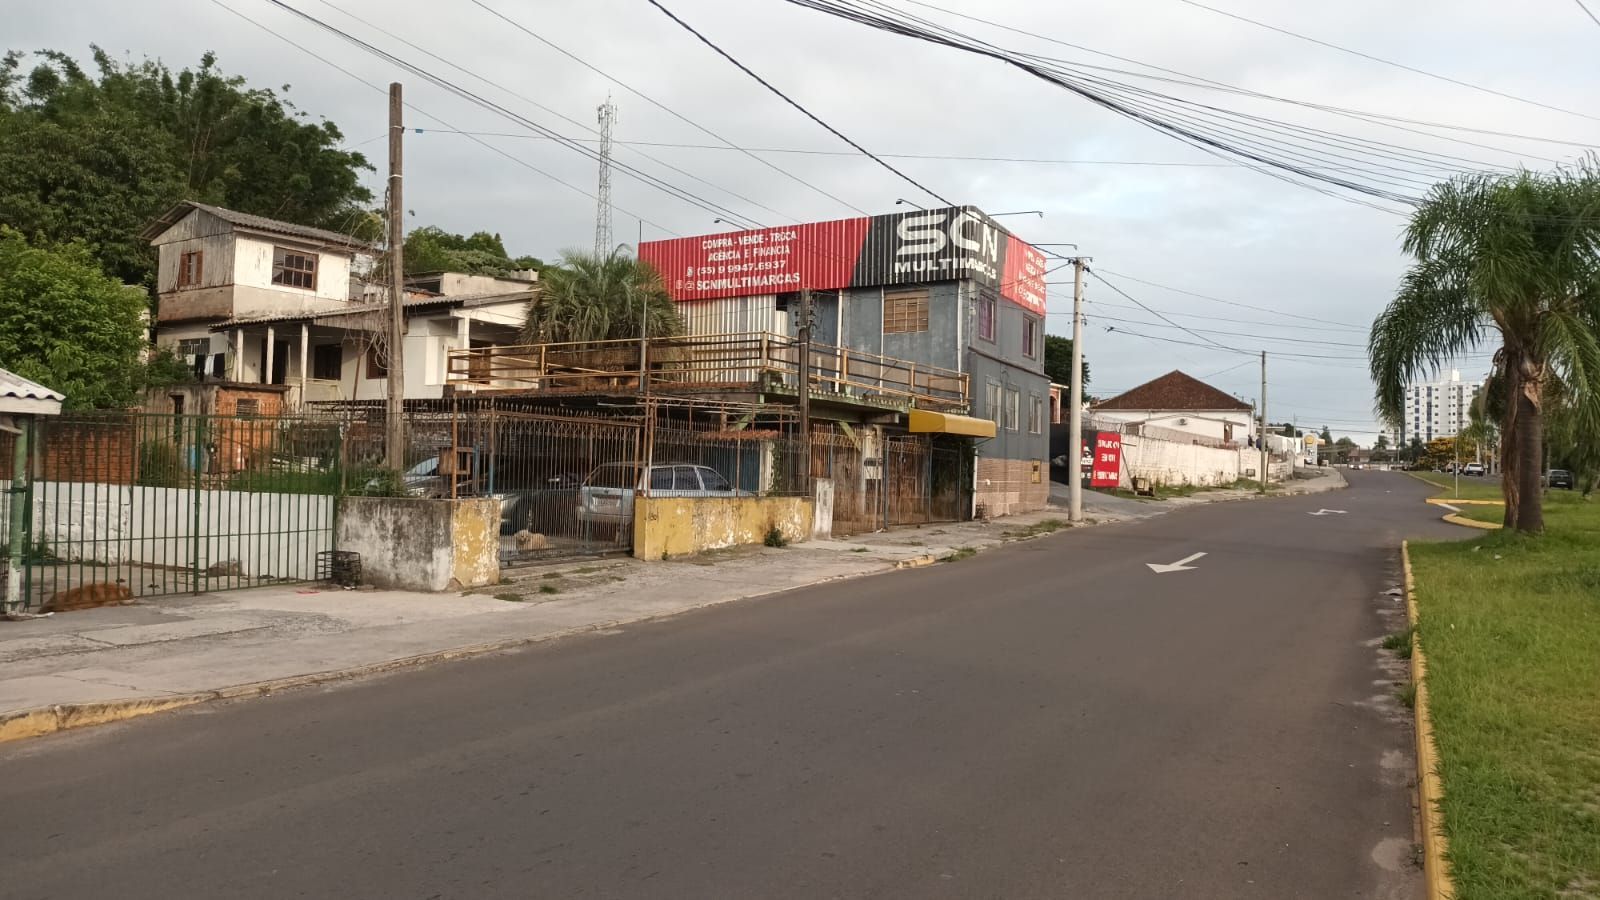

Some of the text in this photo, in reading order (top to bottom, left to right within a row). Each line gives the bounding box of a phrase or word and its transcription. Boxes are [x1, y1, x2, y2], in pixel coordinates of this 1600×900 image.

[703, 238, 733, 250] COMPRA
[738, 234, 764, 245] VENDE
[770, 230, 797, 242] TROCA
[897, 210, 998, 262] SCN
[753, 245, 790, 257] FINANCIA
[697, 266, 715, 276] (55)
[718, 265, 725, 273] 9
[696, 272, 801, 291] SCNMULTIMARCAS
